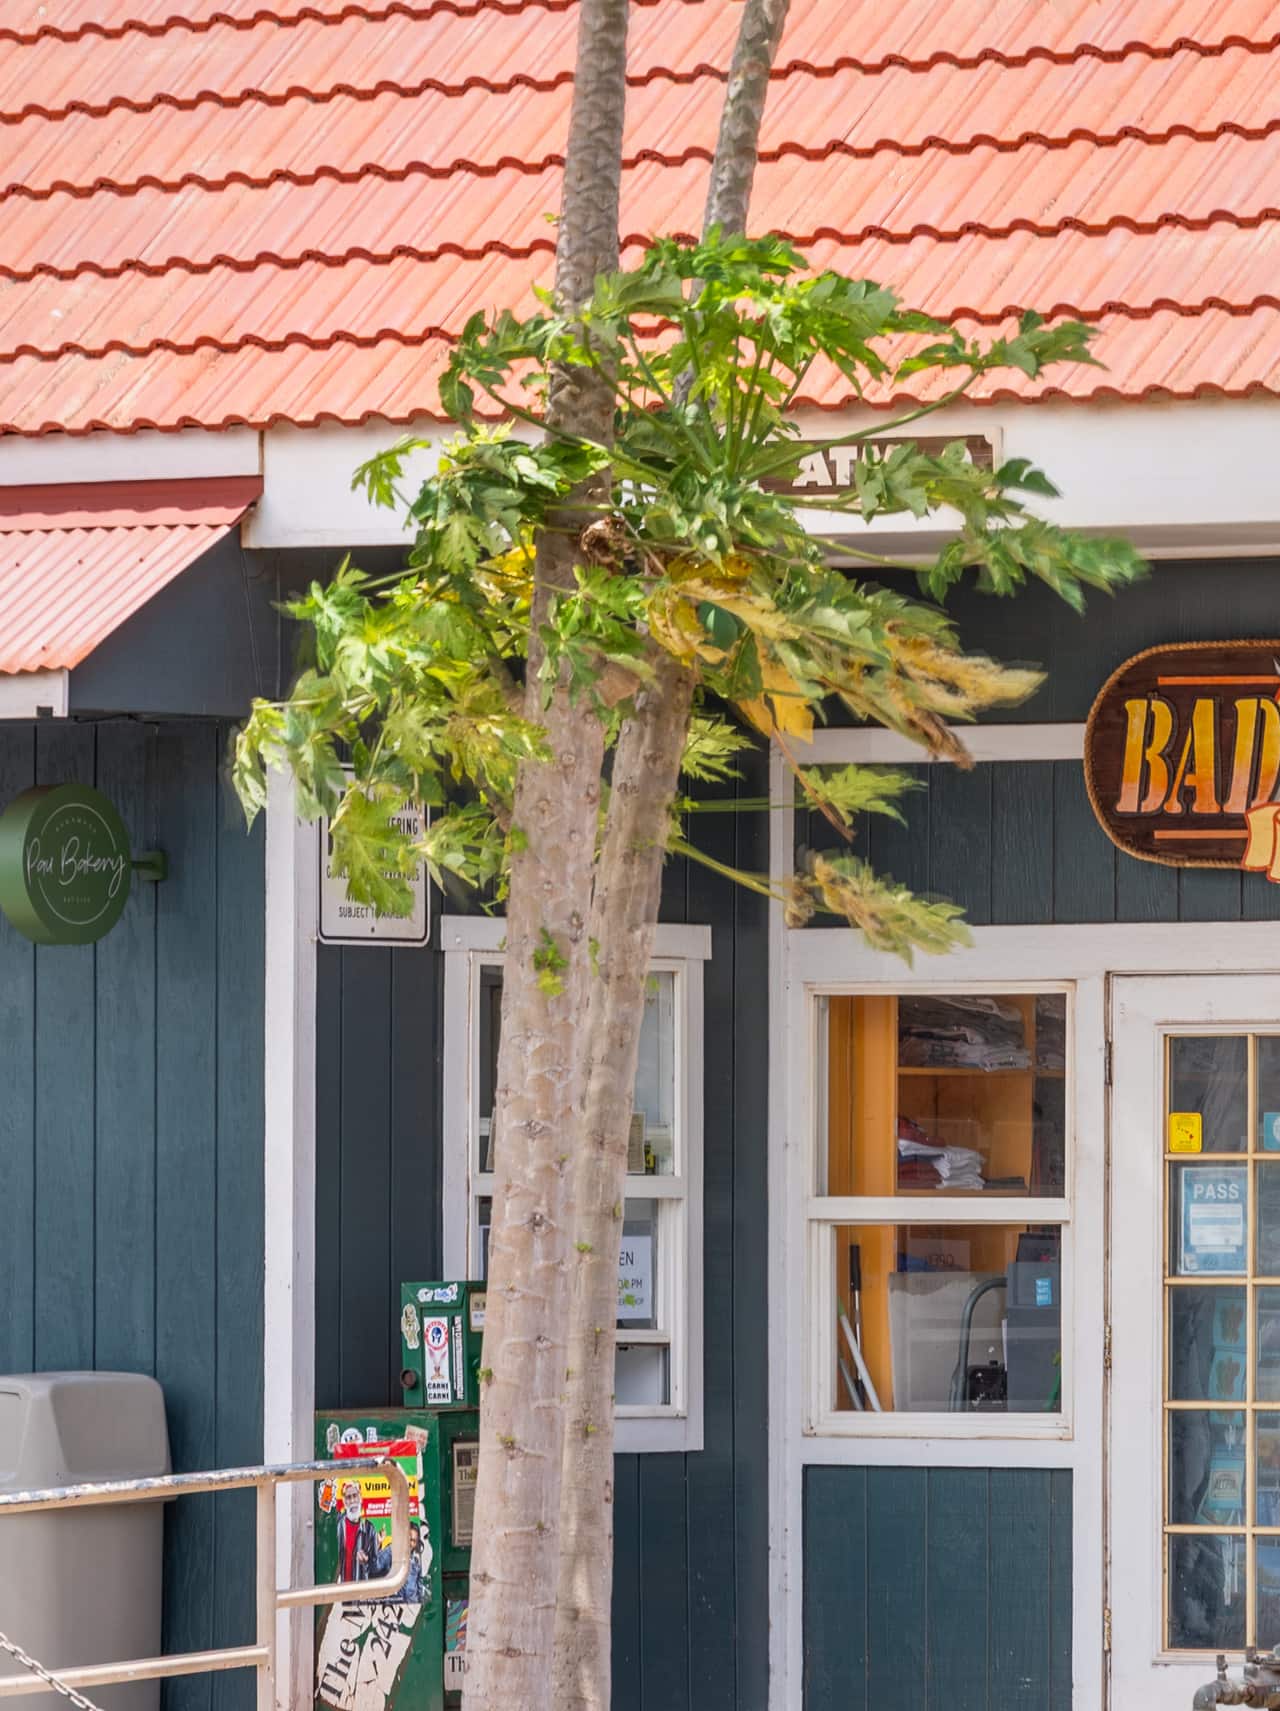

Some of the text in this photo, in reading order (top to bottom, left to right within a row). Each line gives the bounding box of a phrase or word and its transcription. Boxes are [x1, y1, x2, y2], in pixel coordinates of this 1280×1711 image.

[58, 836, 126, 898] Bakery
[338, 906, 368, 919] SUBJECT
[1193, 1184, 1240, 1200] PASS
[319, 1637, 358, 1699] The
